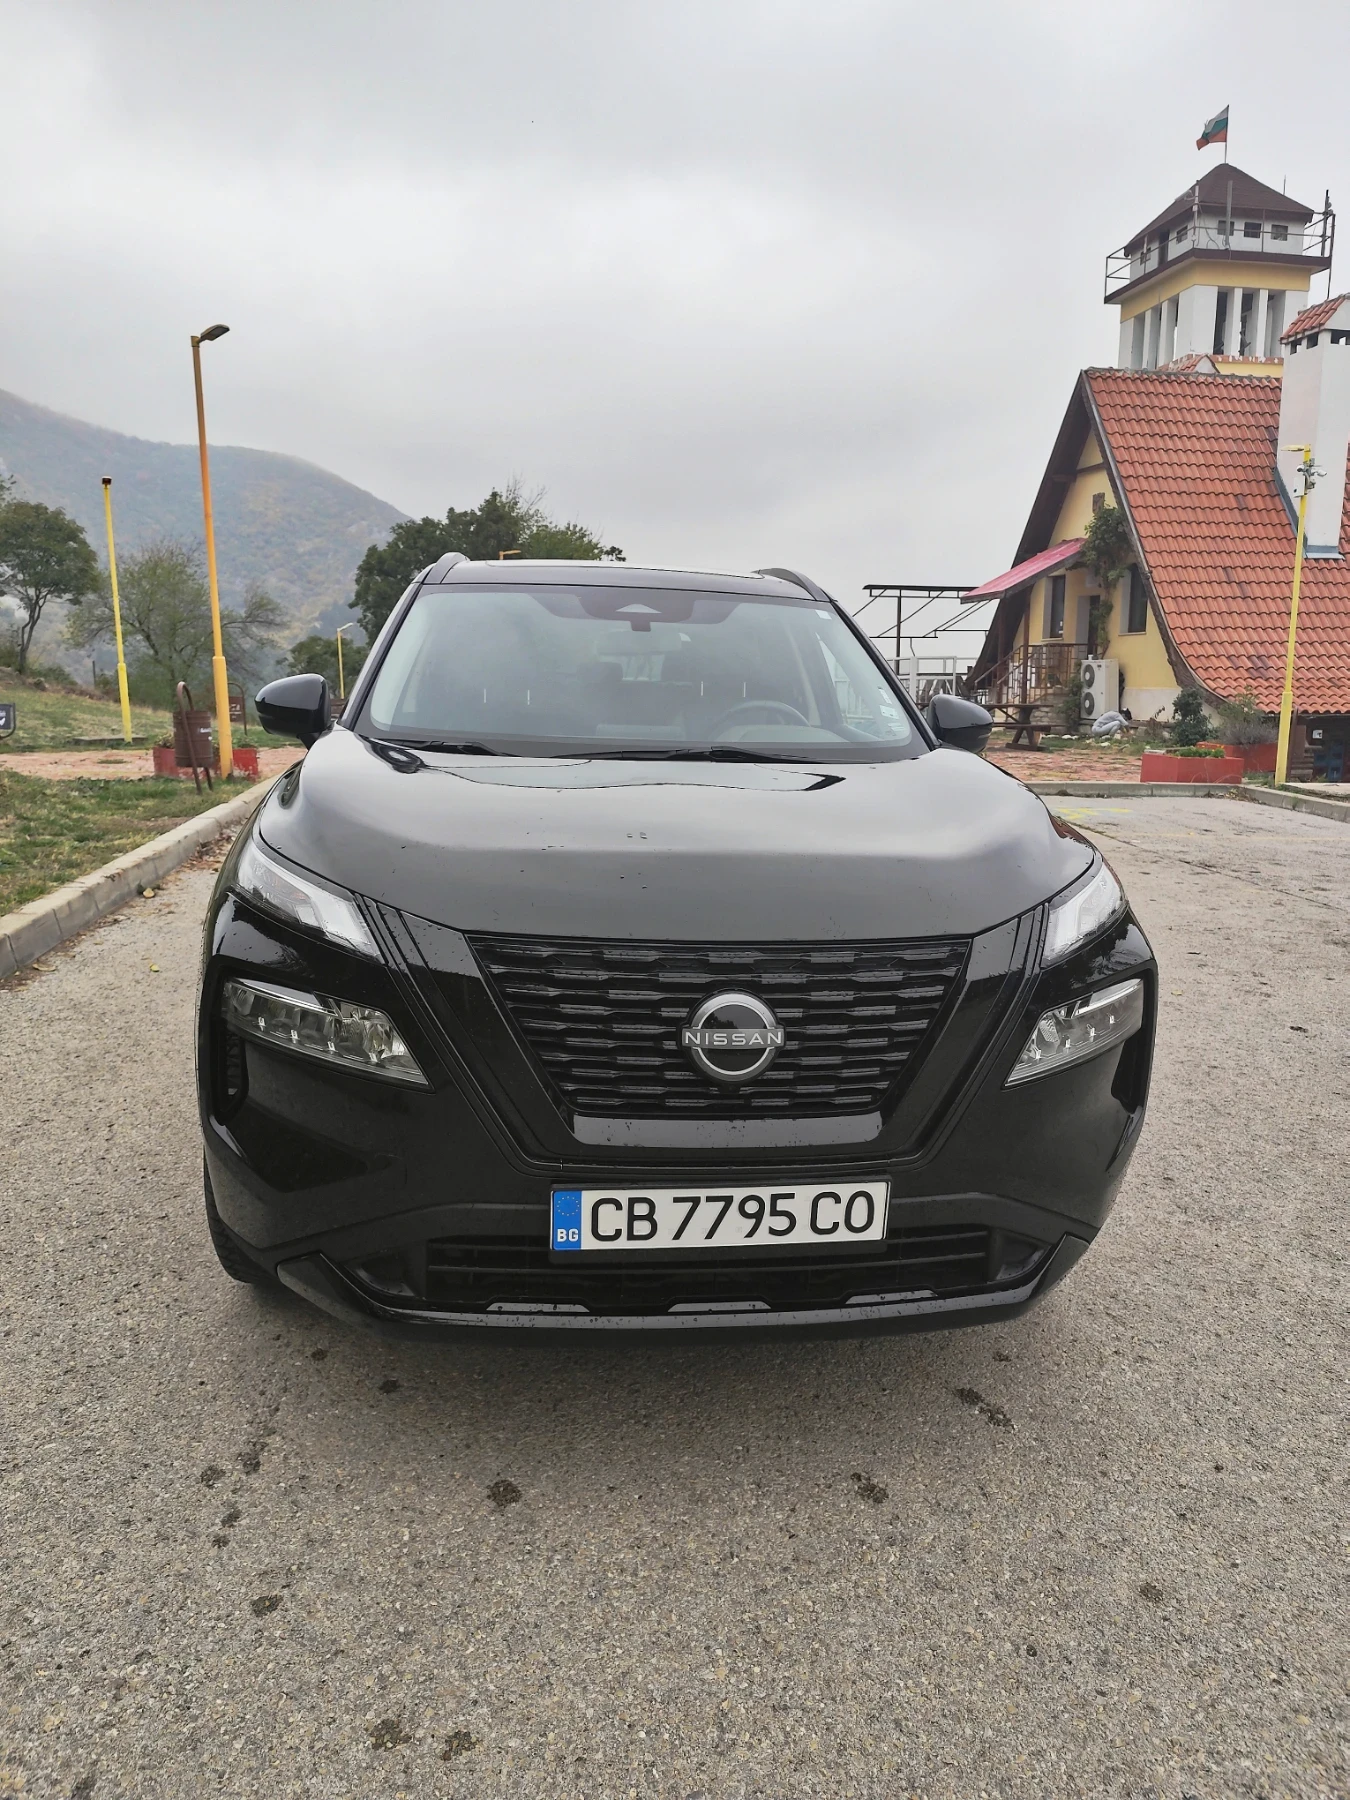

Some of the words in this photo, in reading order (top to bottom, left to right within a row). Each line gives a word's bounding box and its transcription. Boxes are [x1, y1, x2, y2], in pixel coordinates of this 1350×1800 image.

[685, 1031, 782, 1046] NISSAN
[591, 1197, 658, 1242] CB
[671, 1192, 797, 1240] 7795
[810, 1190, 875, 1235] CO
[557, 1228, 579, 1242] BG
